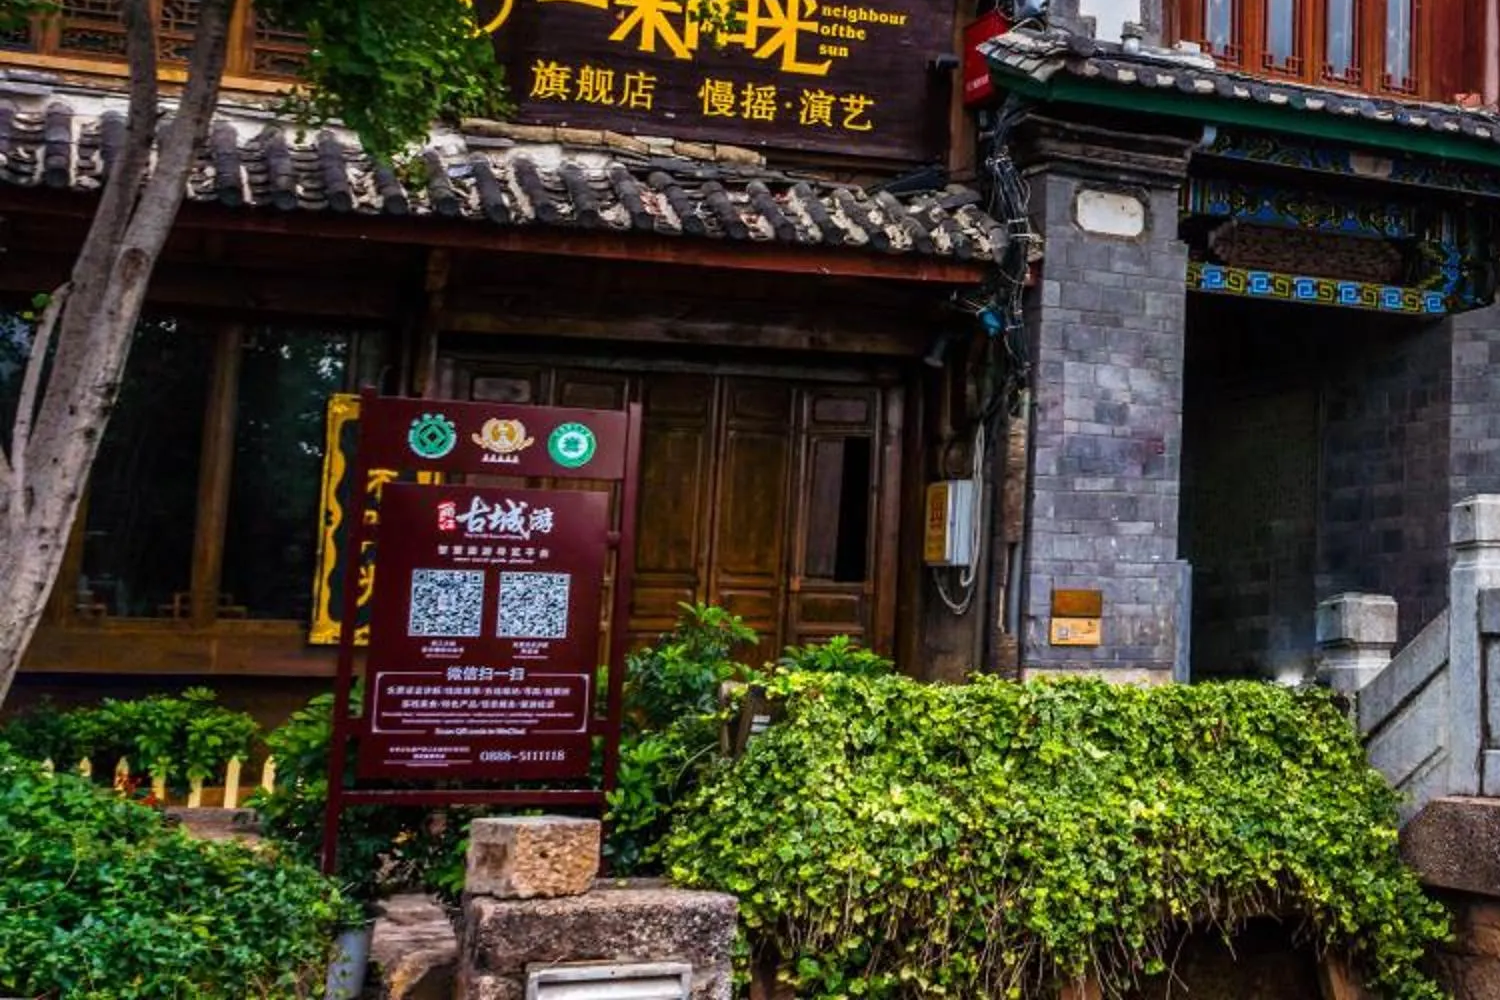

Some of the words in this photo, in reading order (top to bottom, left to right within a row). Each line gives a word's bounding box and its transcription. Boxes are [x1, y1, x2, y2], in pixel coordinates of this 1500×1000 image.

[821, 4, 908, 25] neighbour
[819, 43, 849, 57] sun
[529, 58, 657, 111] 旗舰店
[698, 77, 875, 132] 慢摇·演艺
[447, 666, 525, 681] 微信扫一扫
